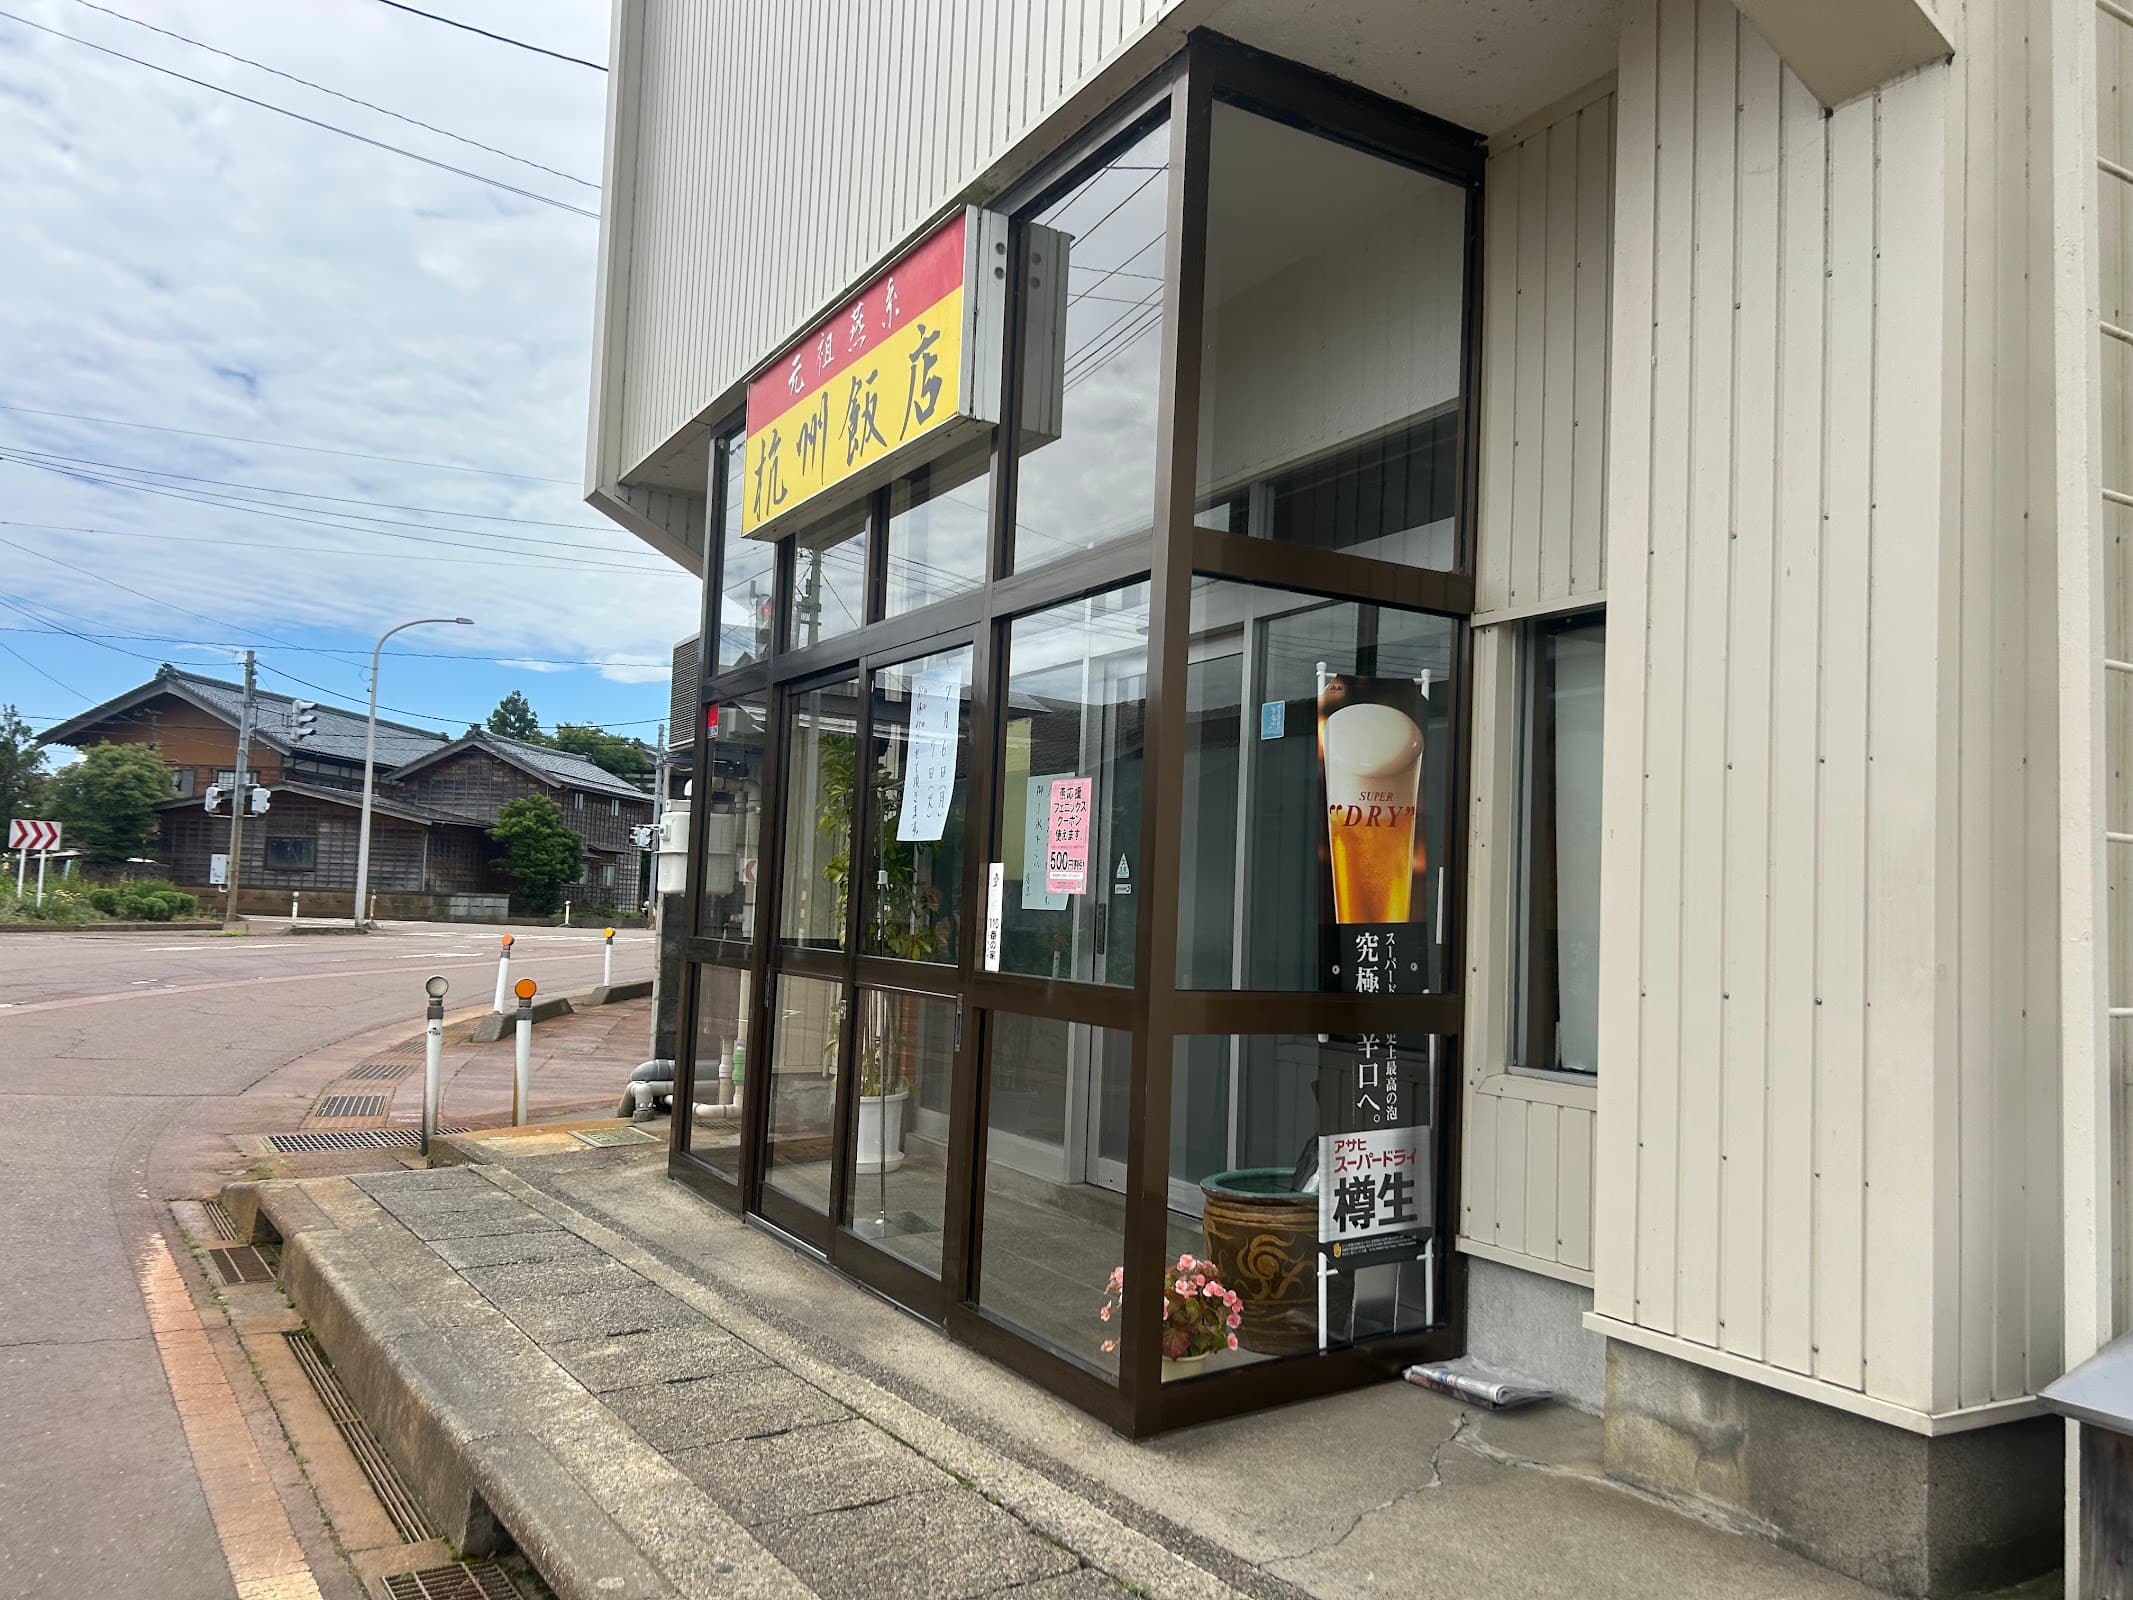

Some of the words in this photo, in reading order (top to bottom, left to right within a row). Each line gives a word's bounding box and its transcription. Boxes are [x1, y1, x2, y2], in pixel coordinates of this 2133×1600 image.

[753, 323, 944, 523] 杭州飯店
[1359, 791, 1394, 802] SUPER
[1054, 801, 1087, 813] フェニックス
[1057, 815, 1082, 827] クーポン
[1334, 1138, 1367, 1154] アサヒ
[1334, 1147, 1417, 1174] スーパードライ
[1332, 1171, 1418, 1233] 樽生
